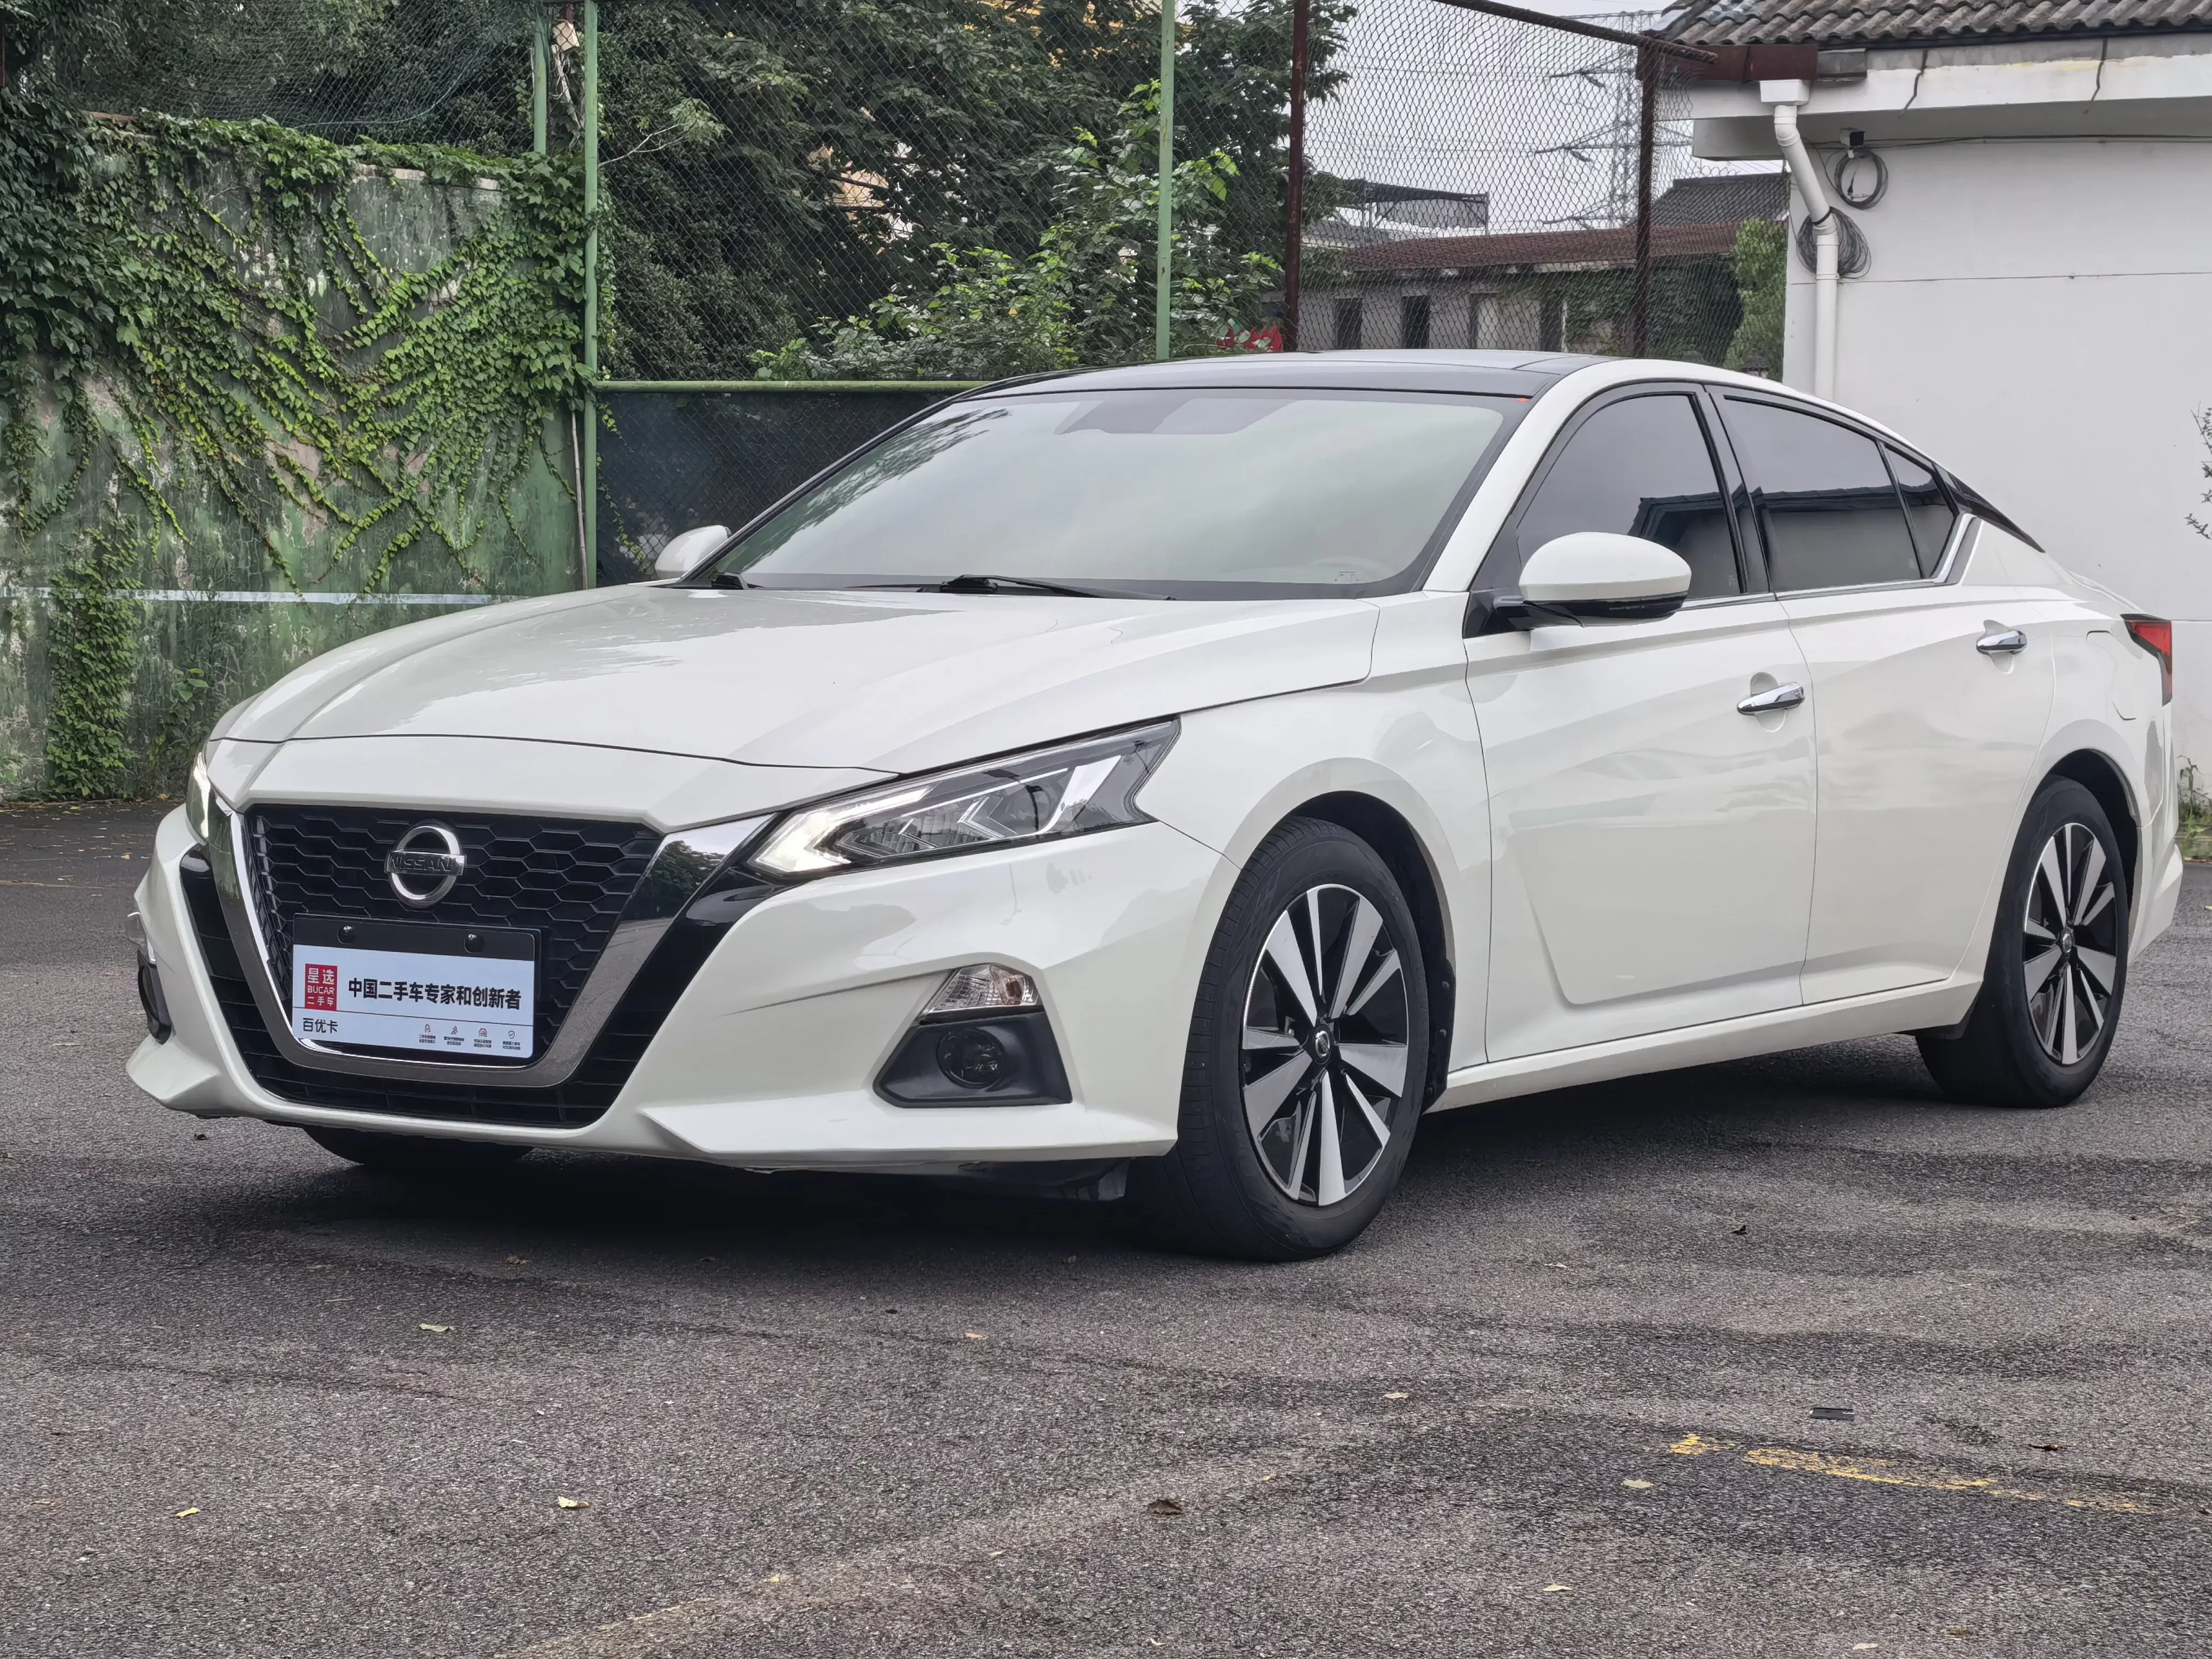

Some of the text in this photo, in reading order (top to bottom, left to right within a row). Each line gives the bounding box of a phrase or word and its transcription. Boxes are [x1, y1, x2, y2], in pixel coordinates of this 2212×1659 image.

[389, 855, 451, 872] NISSAN
[307, 968, 334, 984] 星选
[307, 986, 335, 995] BUCAR
[348, 977, 522, 1010] 中国二手车专家和创新者
[307, 996, 334, 1007] 二手车
[303, 1017, 339, 1034] 百优卡
